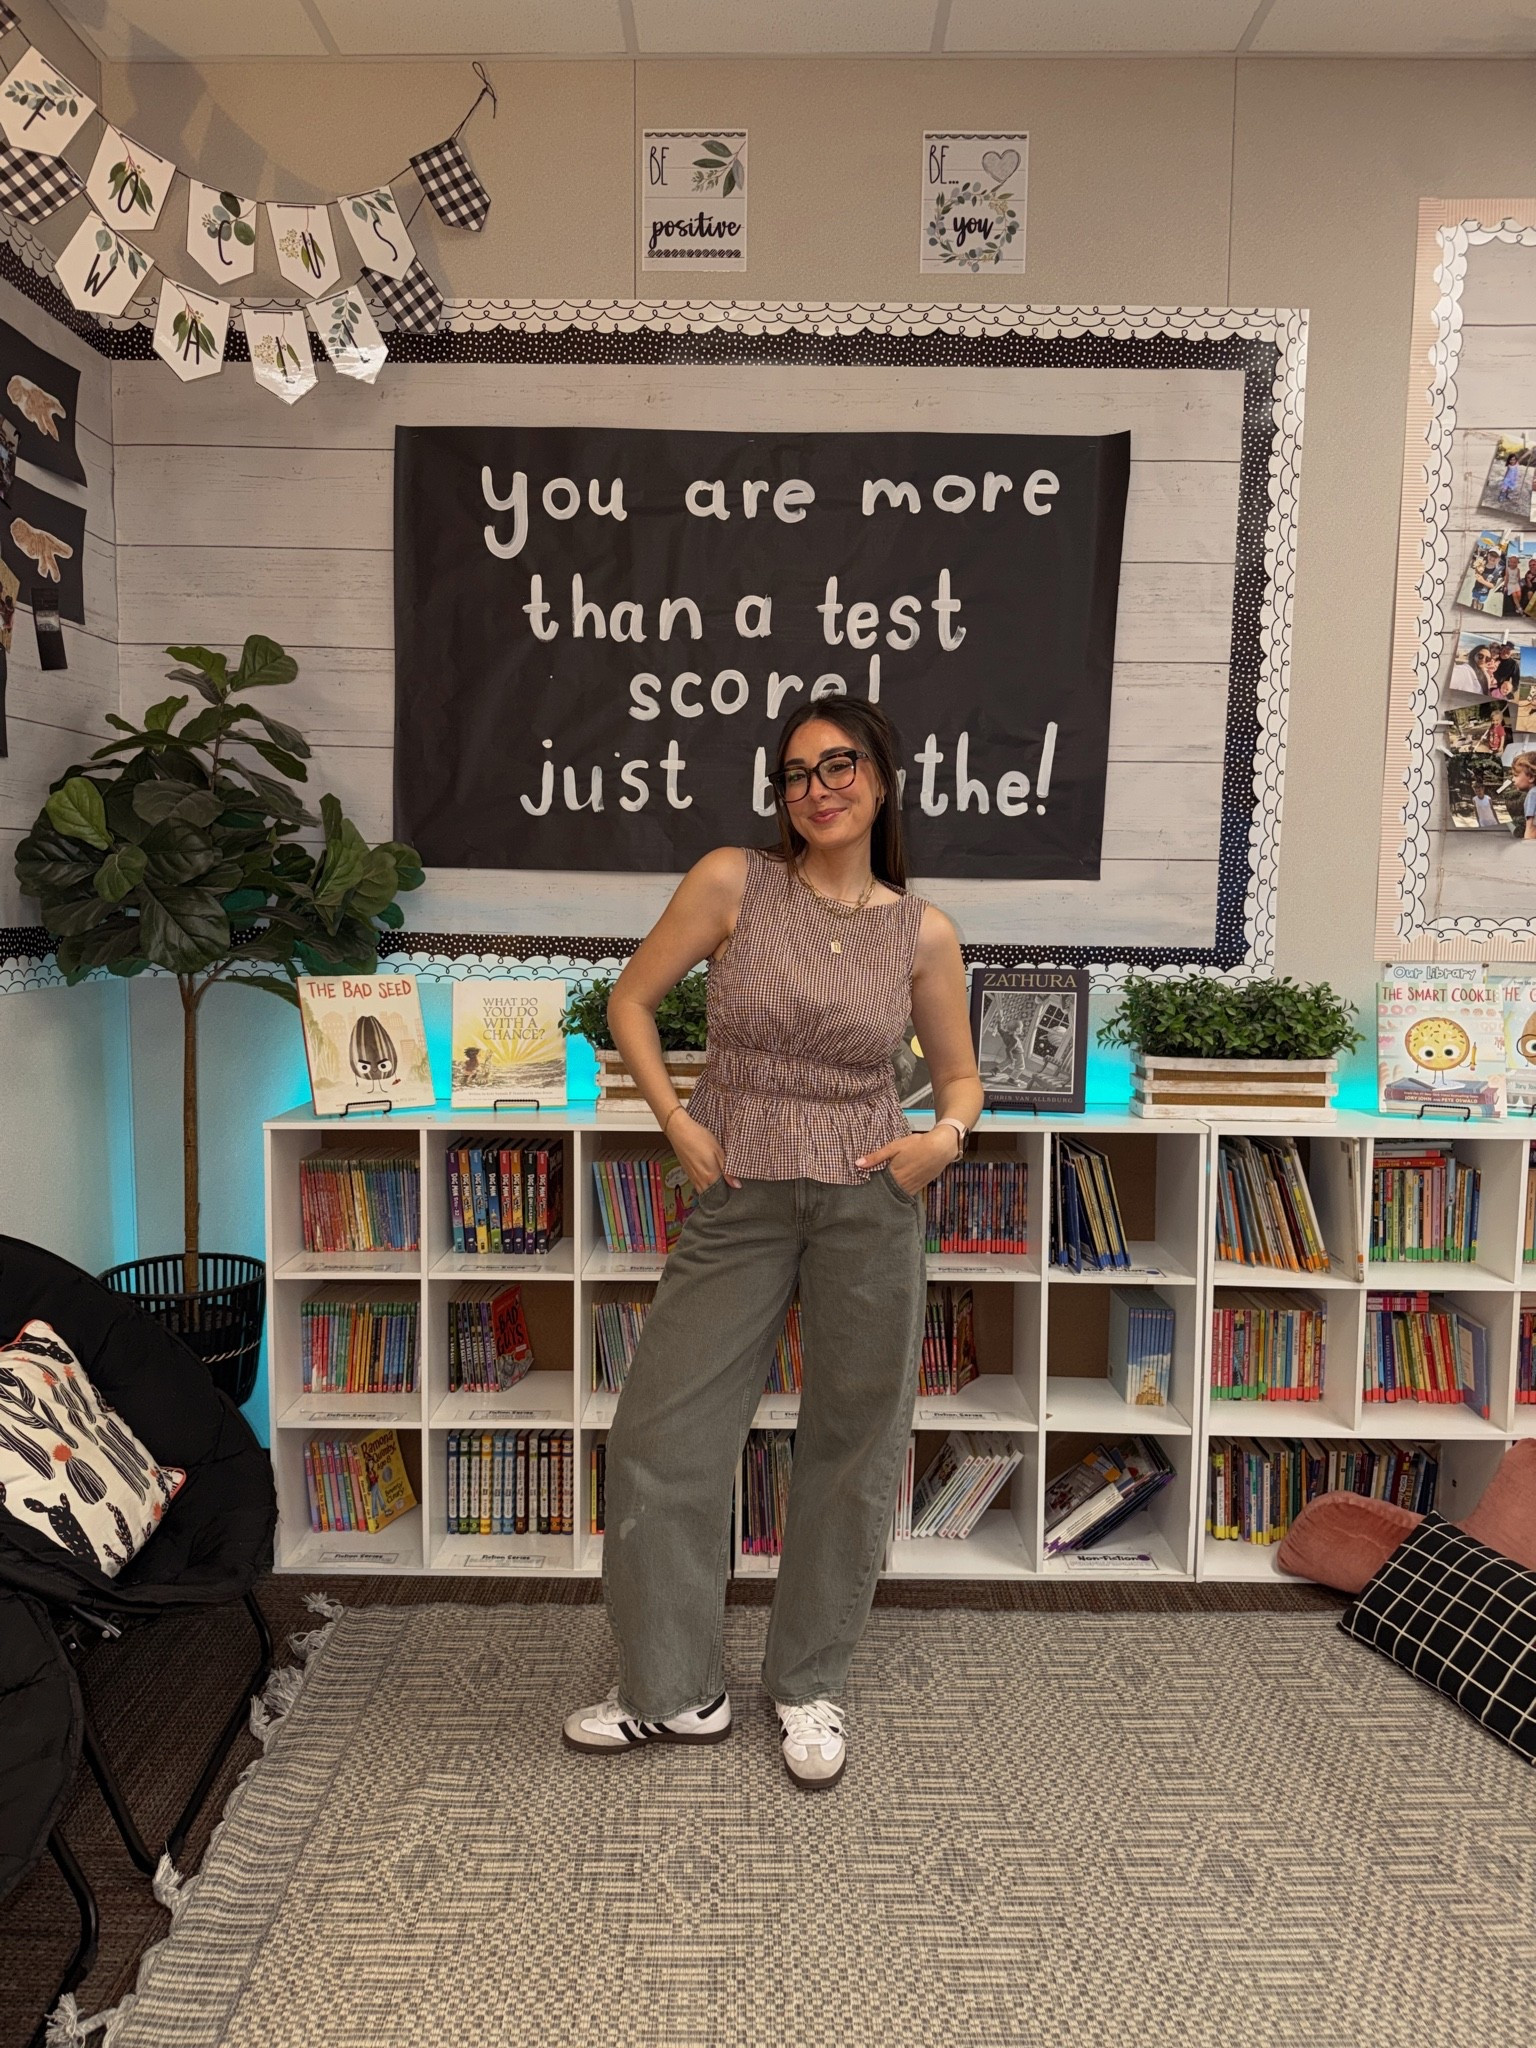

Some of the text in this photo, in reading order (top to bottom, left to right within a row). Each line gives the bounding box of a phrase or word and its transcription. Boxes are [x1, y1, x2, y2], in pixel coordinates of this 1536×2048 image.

[649, 146, 669, 186] BE
[648, 211, 741, 250] positive
[953, 214, 994, 247] you
[481, 465, 1060, 560] you are more
[522, 568, 967, 652] than a test
[519, 721, 1058, 818] just bthe!
[983, 973, 1078, 988] ZATHURA
[1393, 966, 1477, 980] Our Library
[306, 979, 412, 1000] THE BAD SEED
[1382, 986, 1403, 1000] THE
[1408, 986, 1447, 1002] SMART
[1502, 986, 1520, 1001] HE
[482, 997, 538, 1006] WHAT DO
[482, 1006, 538, 1017] YOU DO
[483, 1017, 538, 1029] WITH A
[482, 1028, 546, 1040] CHANCE?
[498, 1305, 519, 1334] BAD
[496, 1323, 525, 1357] GUYS
[361, 1431, 394, 1459] Ramona
[377, 1455, 392, 1470] Age 8
